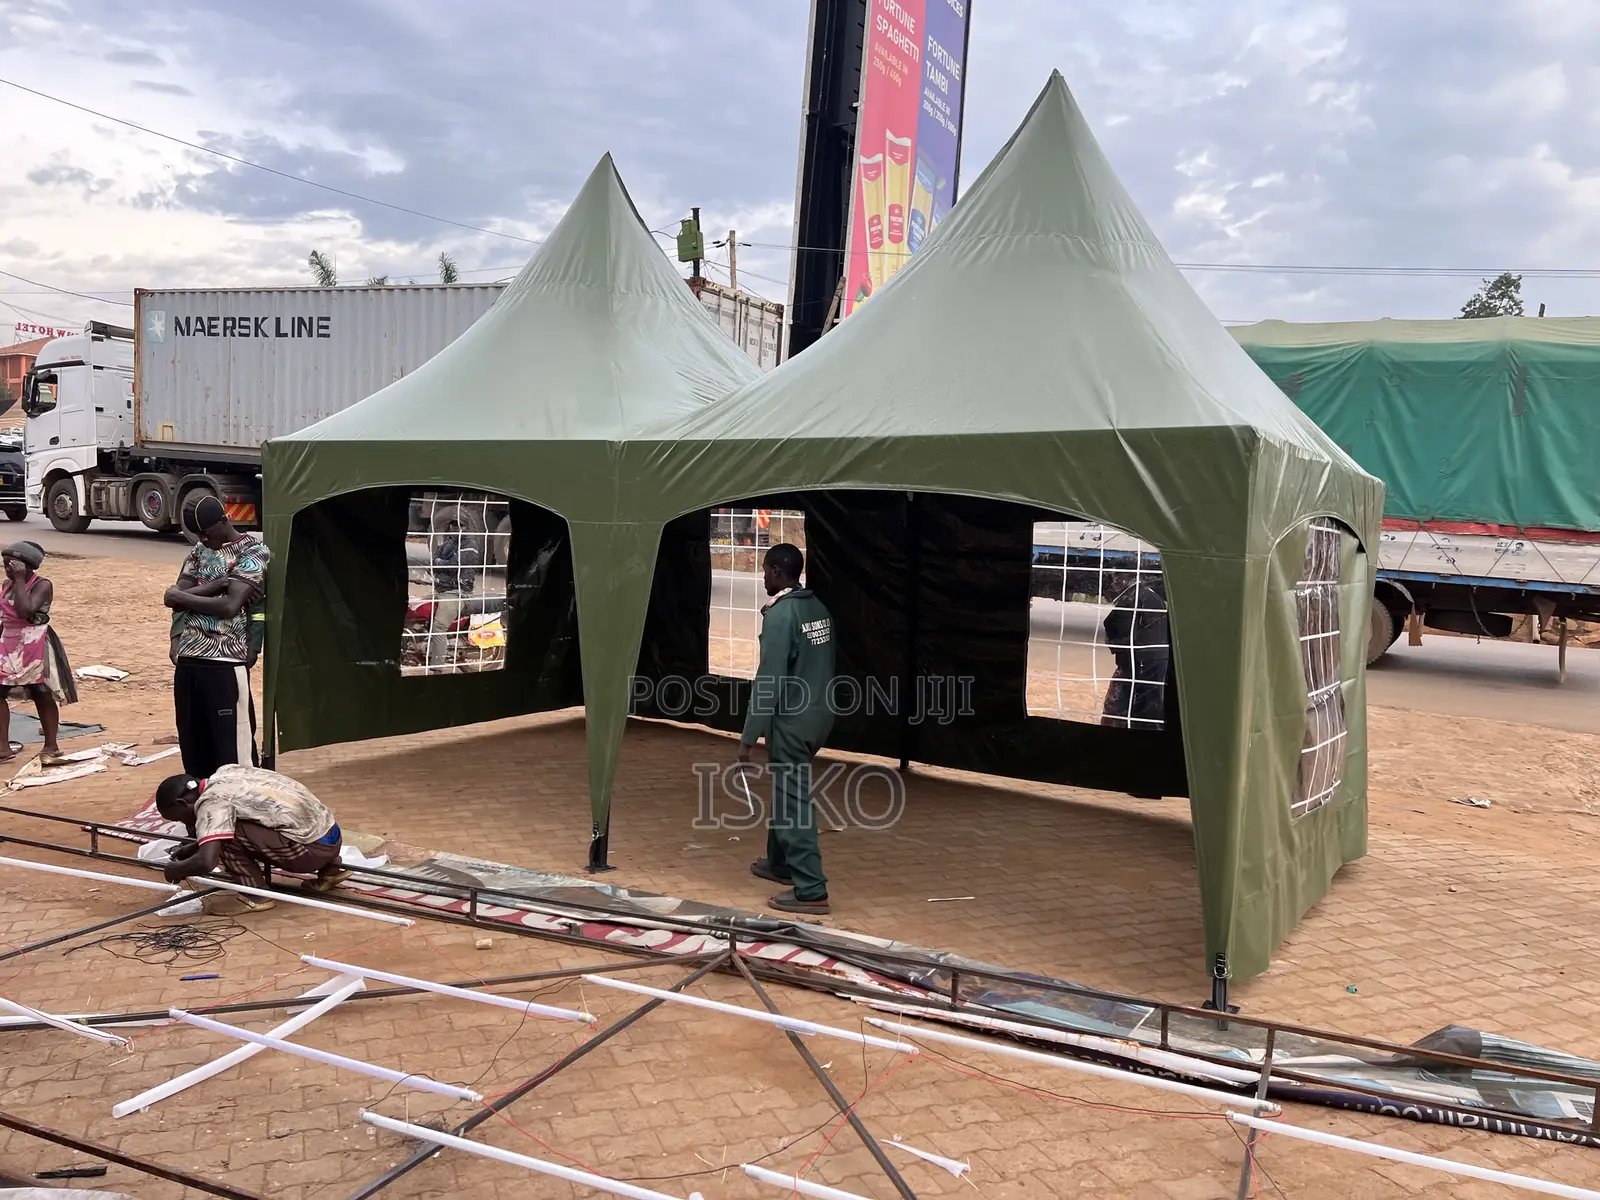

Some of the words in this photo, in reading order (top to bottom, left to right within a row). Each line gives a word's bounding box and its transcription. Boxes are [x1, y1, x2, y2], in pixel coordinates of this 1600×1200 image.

[878, 0, 916, 35] ORTUNE
[876, 14, 919, 63] SPAGHETTI
[927, 35, 960, 81] FORTUNE
[926, 60, 948, 95] TAMBI
[924, 86, 946, 112] AVAILABLE
[174, 316, 269, 338] MAERSK
[275, 316, 331, 338] LINE
